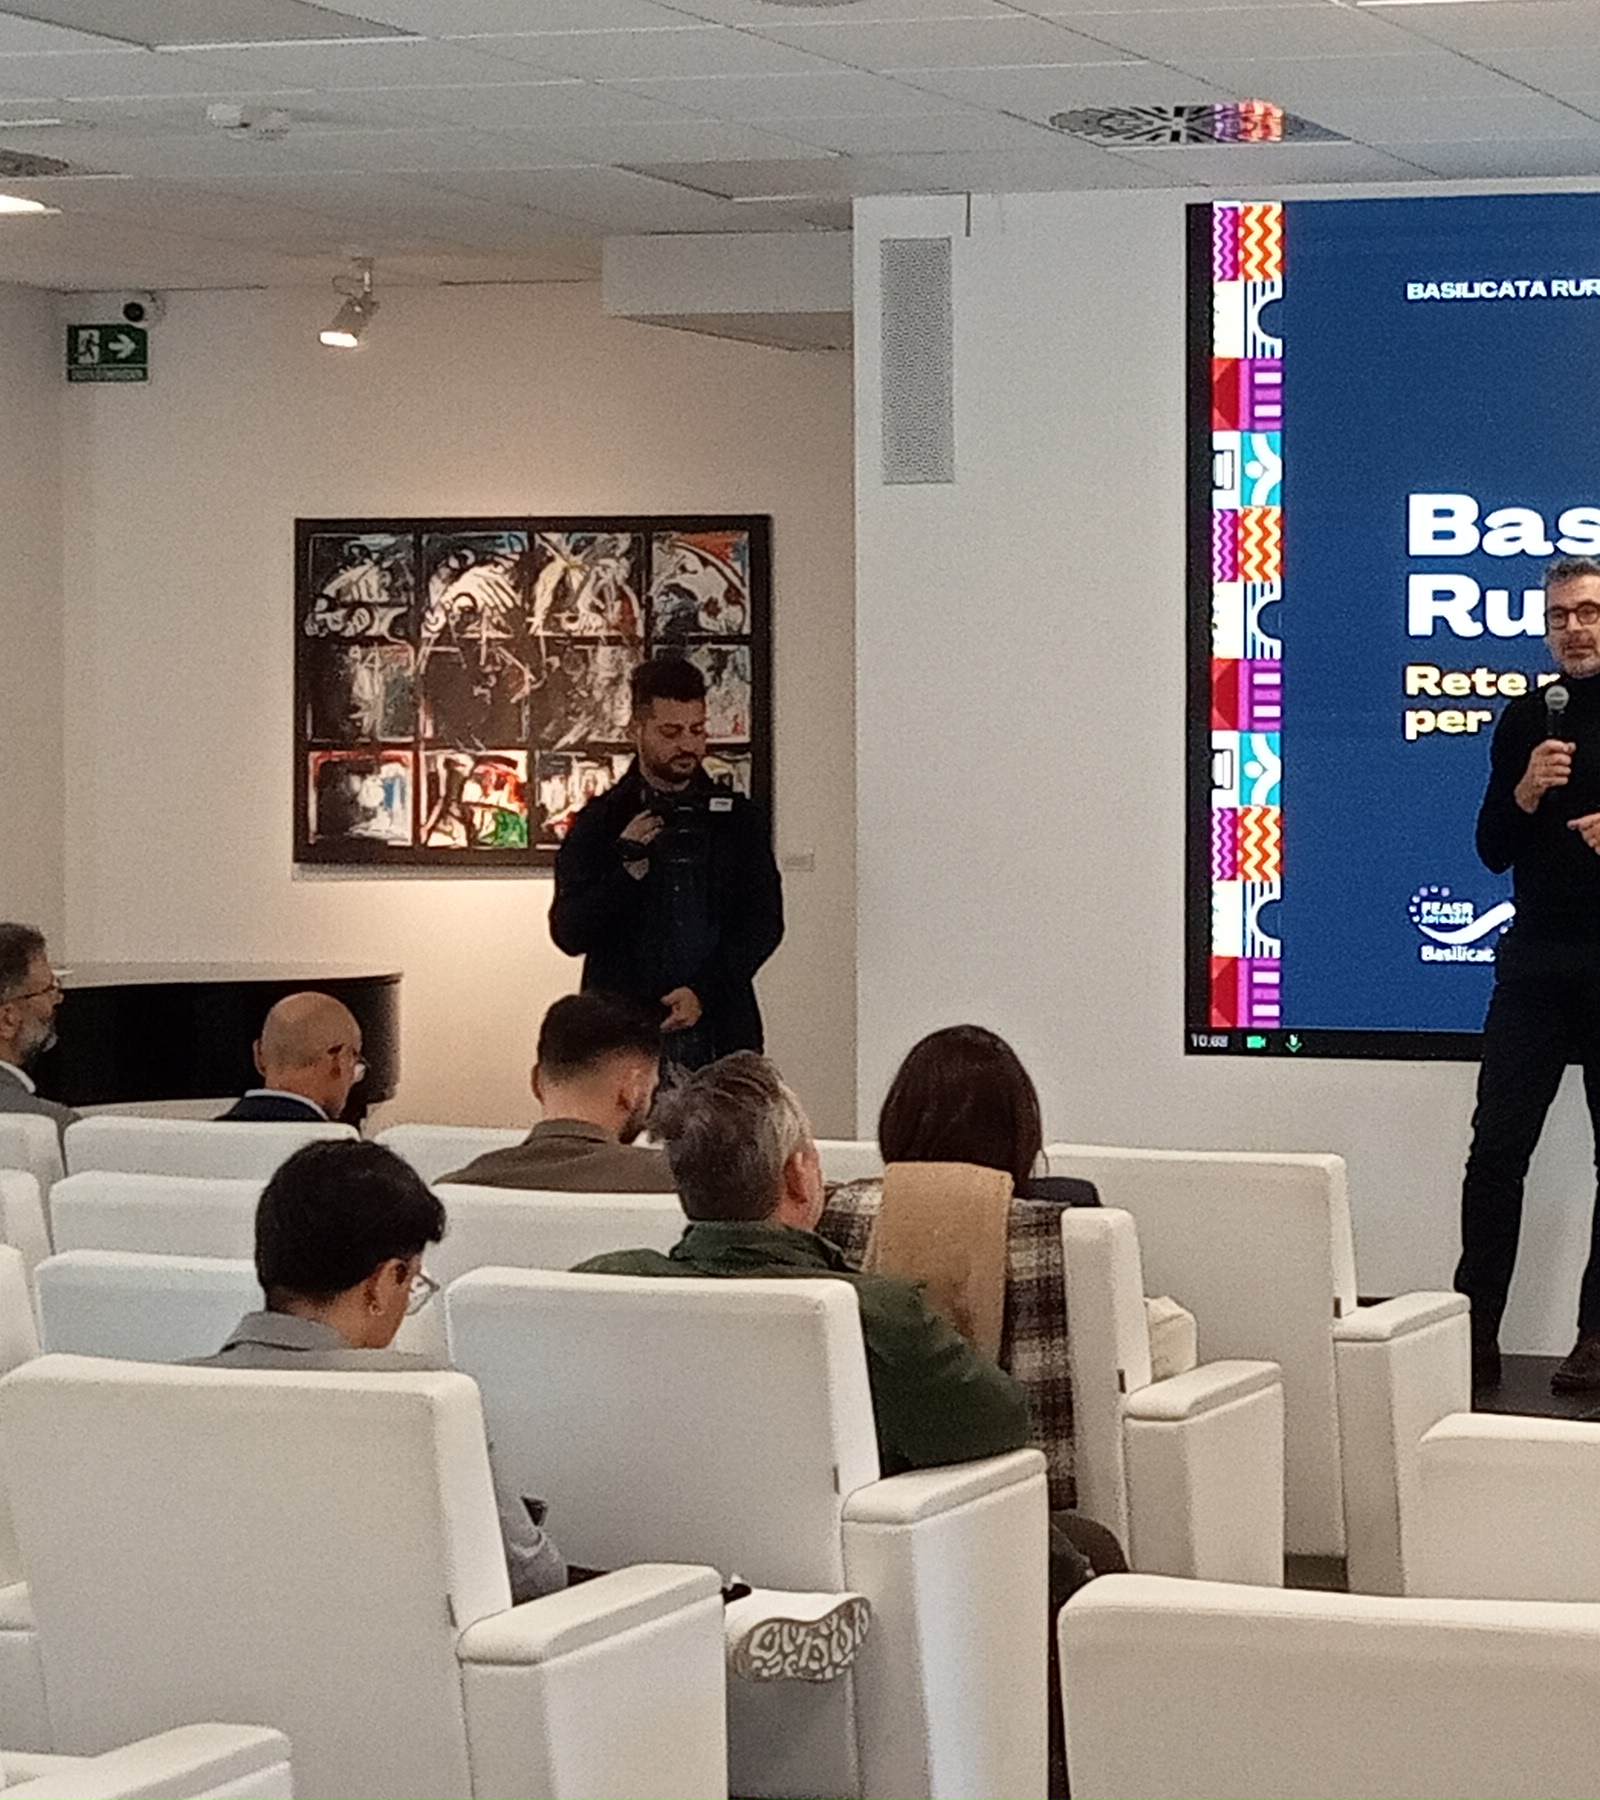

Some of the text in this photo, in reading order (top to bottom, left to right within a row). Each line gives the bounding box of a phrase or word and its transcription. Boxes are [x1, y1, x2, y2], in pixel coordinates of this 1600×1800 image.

[1407, 280, 1547, 299] BASILICATA
[1405, 664, 1527, 697] Rete
[1405, 708, 1492, 740] per
[1421, 945, 1497, 962] Basilicat
